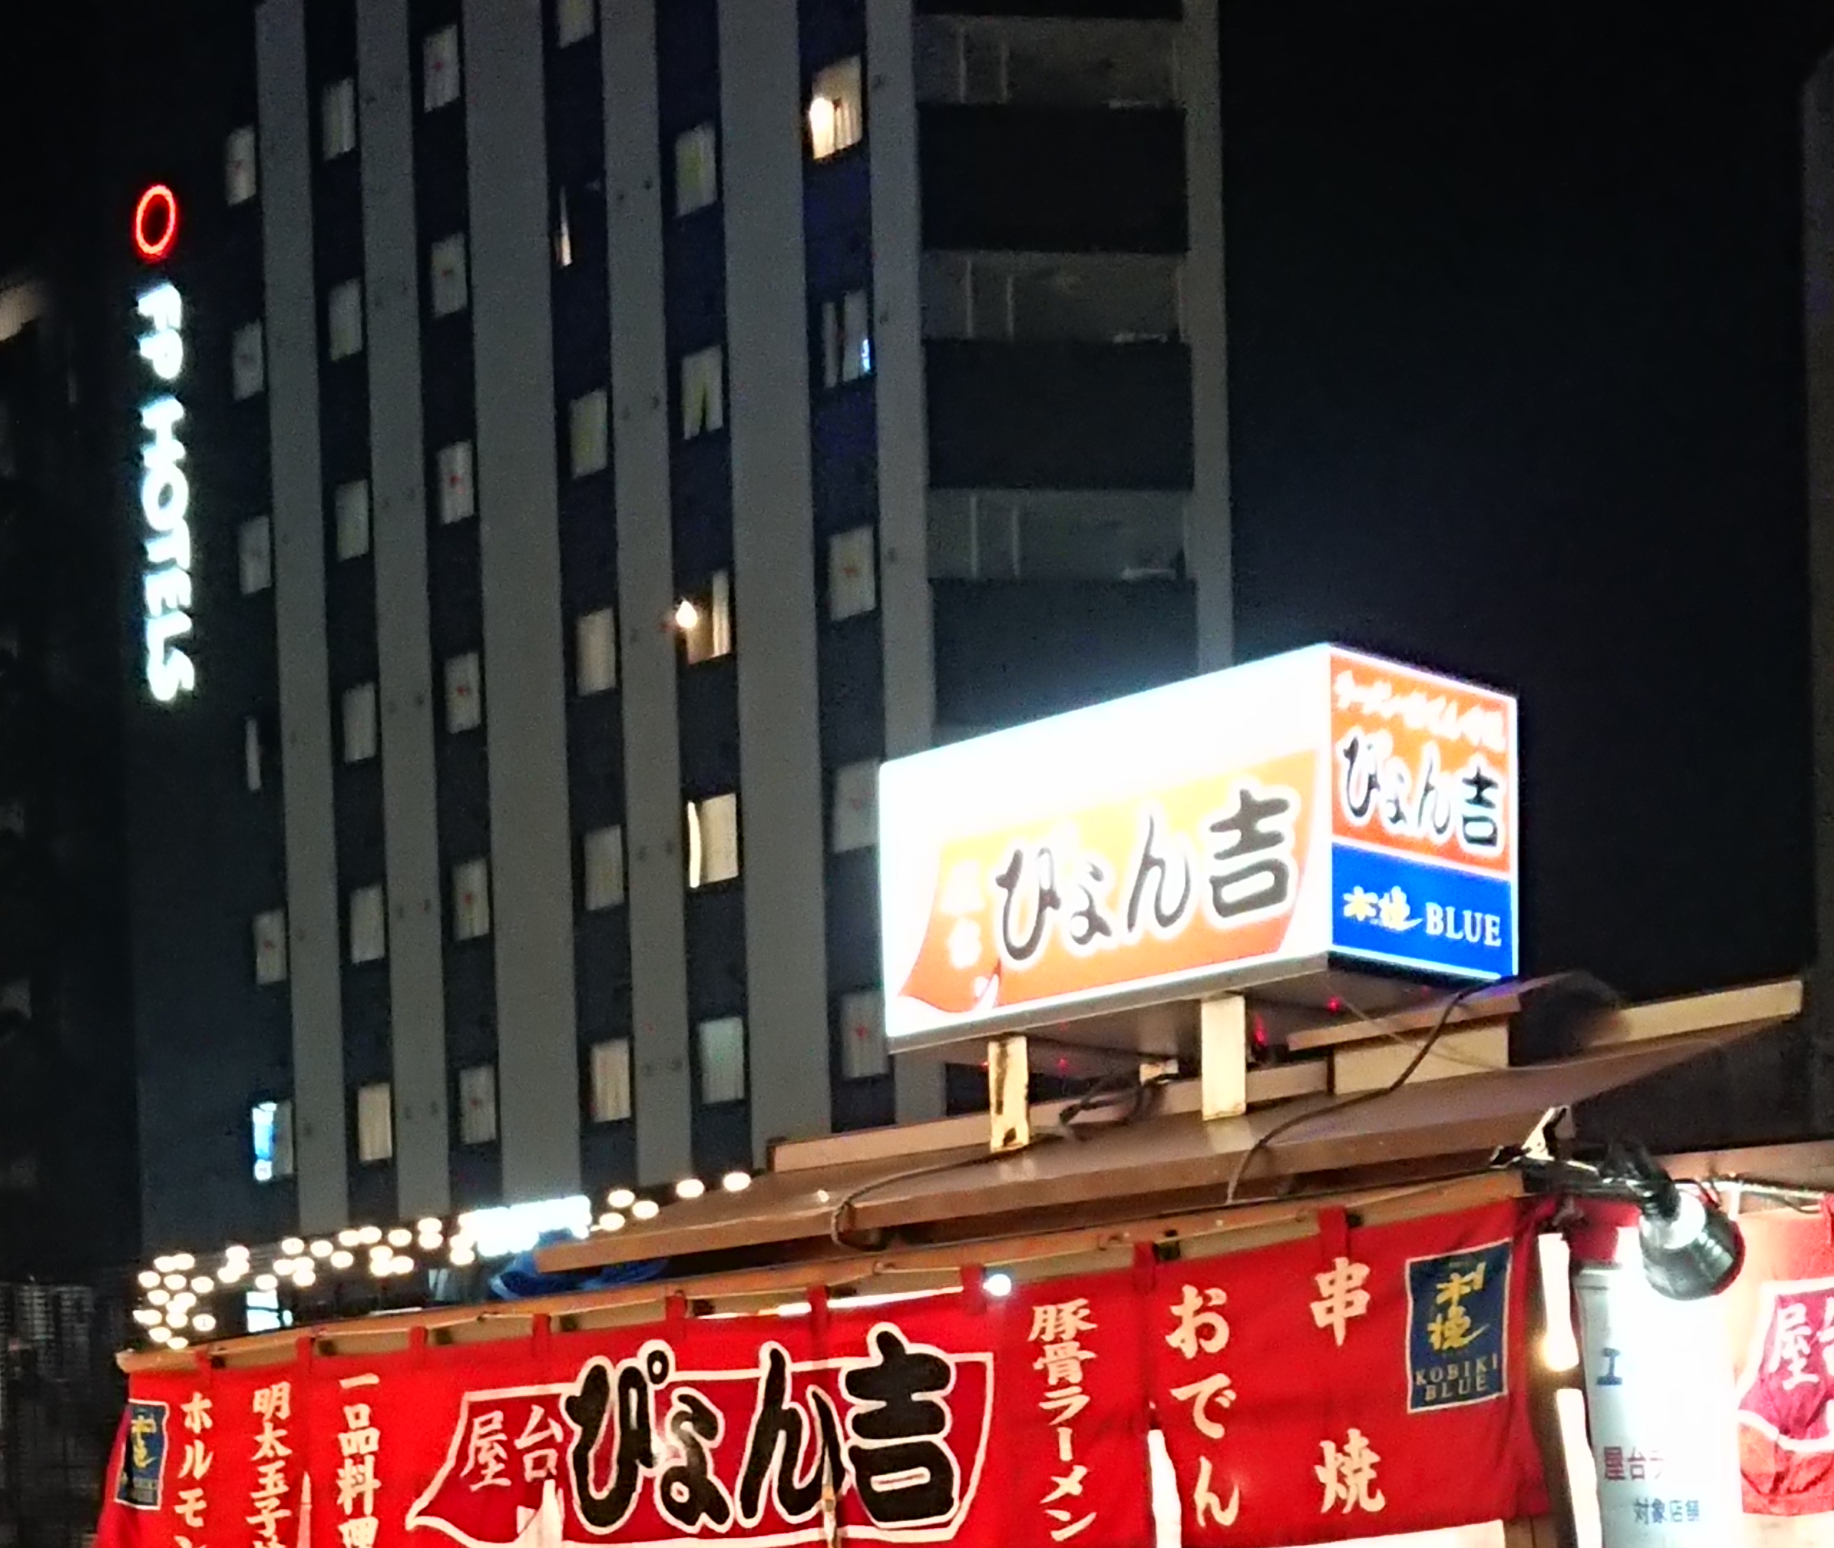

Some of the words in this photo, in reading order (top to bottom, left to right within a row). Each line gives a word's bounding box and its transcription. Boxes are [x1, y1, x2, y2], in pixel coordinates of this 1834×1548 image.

[141, 395, 195, 701] HOTELS
[1426, 902, 1503, 947] BLUE
[461, 1404, 565, 1493] 屋台
[565, 1330, 955, 1530] ぴょん吉
[1028, 1297, 1099, 1543] 豚骨ラーメン
[1165, 1283, 1241, 1528] おでん
[1309, 1256, 1387, 1514] 串焼
[1415, 1353, 1498, 1386] KOBIKI
[1424, 1374, 1488, 1402] BLUE
